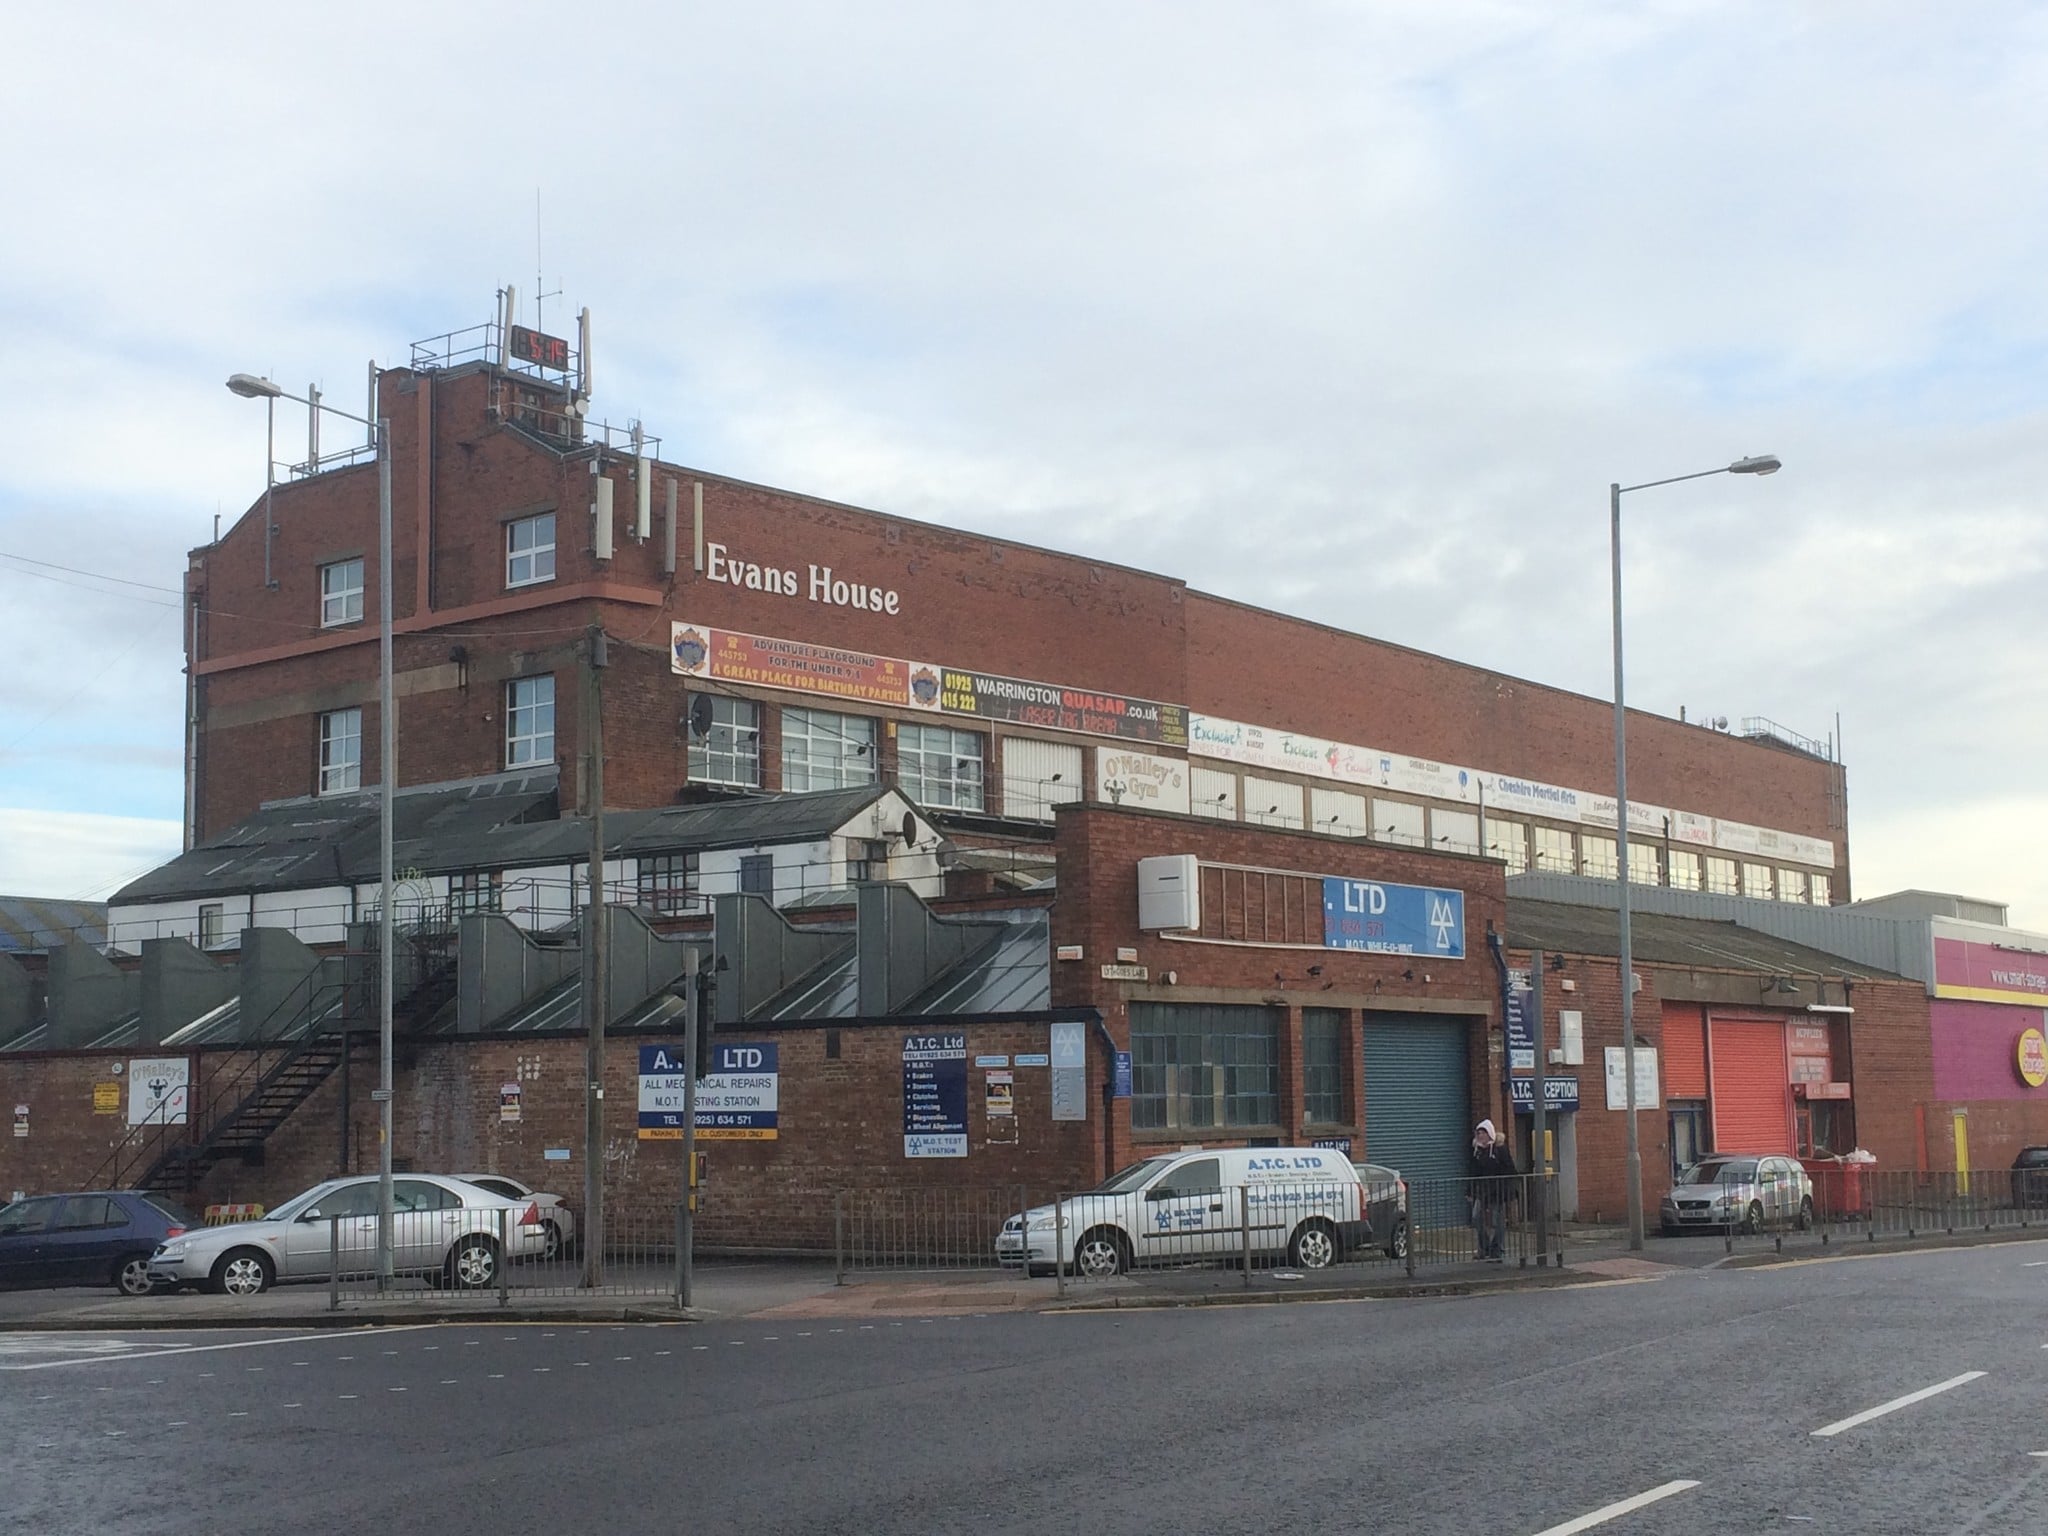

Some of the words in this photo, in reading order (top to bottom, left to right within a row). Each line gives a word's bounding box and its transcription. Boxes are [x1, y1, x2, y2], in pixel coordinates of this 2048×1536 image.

[707, 542, 798, 597] Evans
[808, 564, 900, 615] House
[753, 639, 808, 660] ADVENTURE
[812, 646, 875, 668] PLAYGROUND
[768, 656, 788, 667] FOR
[790, 658, 809, 671] THE
[811, 662, 842, 676] UNDER
[713, 663, 721, 674] A
[723, 665, 758, 681] GREAT
[761, 670, 793, 686] PLACE
[795, 673, 815, 689] FOR
[818, 678, 866, 697] BIRTHDAY
[868, 686, 907, 703] PARTIES
[945, 673, 972, 692] 01925
[975, 677, 1061, 706] WARRINGTON
[959, 694, 976, 711] 222
[1105, 755, 1181, 788] O'Malley's
[1128, 778, 1159, 800] Gym
[1498, 778, 1532, 798] Cheshire
[1532, 784, 1560, 801] Martial
[1560, 790, 1576, 805] Arts
[1344, 882, 1386, 915] LTD
[905, 1037, 940, 1050] A.T.C.
[944, 1036, 964, 1049] Ltd
[723, 1048, 763, 1068] LTD
[132, 1063, 185, 1081] O'Malley's
[645, 1079, 661, 1089] ALL
[731, 1078, 771, 1088] REPAIRS
[723, 1096, 760, 1106] STATION
[717, 1115, 734, 1125] 634
[737, 1115, 752, 1125] 571
[1248, 1159, 1291, 1170] A.T.C.
[1294, 1157, 1322, 1168] LTD
